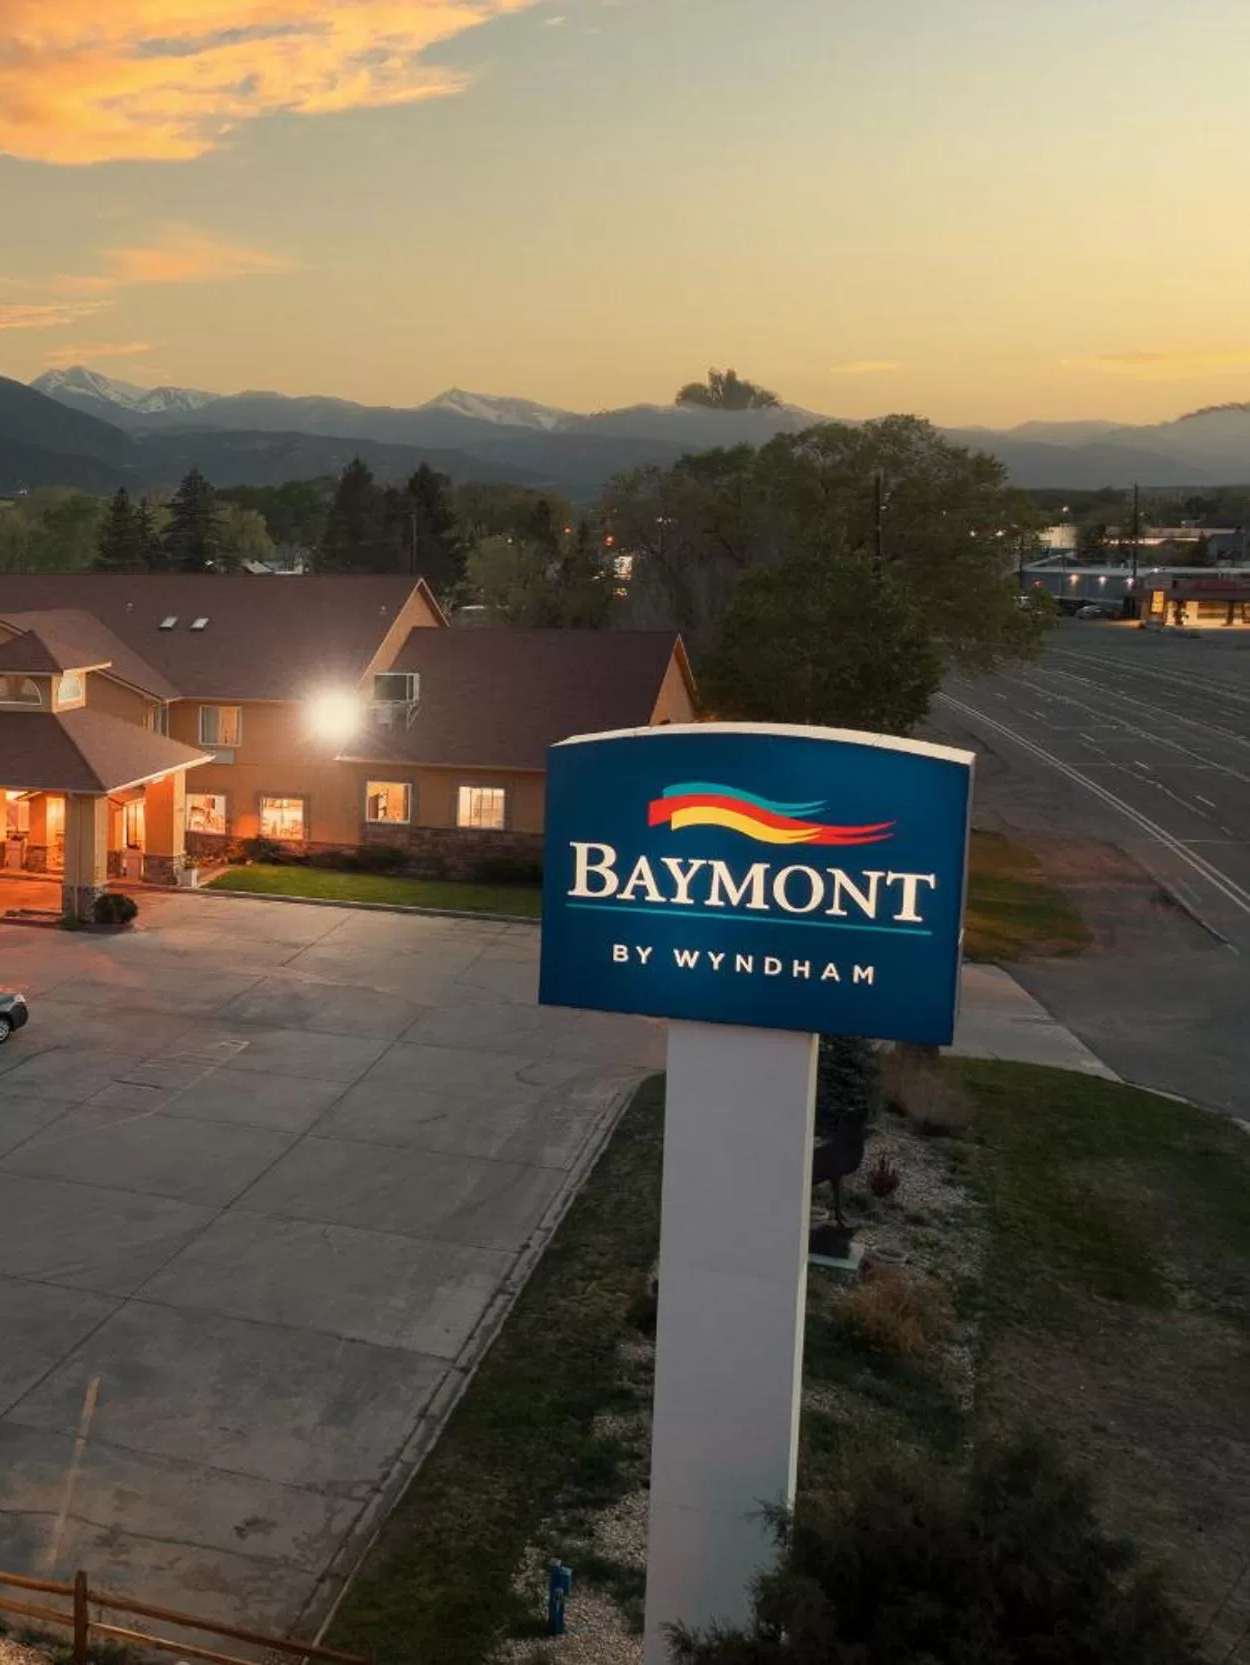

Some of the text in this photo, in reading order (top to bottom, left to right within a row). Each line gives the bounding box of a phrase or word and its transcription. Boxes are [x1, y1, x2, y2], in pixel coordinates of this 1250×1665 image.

[567, 841, 936, 923] BAYMONT
[612, 944, 875, 985] BY WYNDHAM
